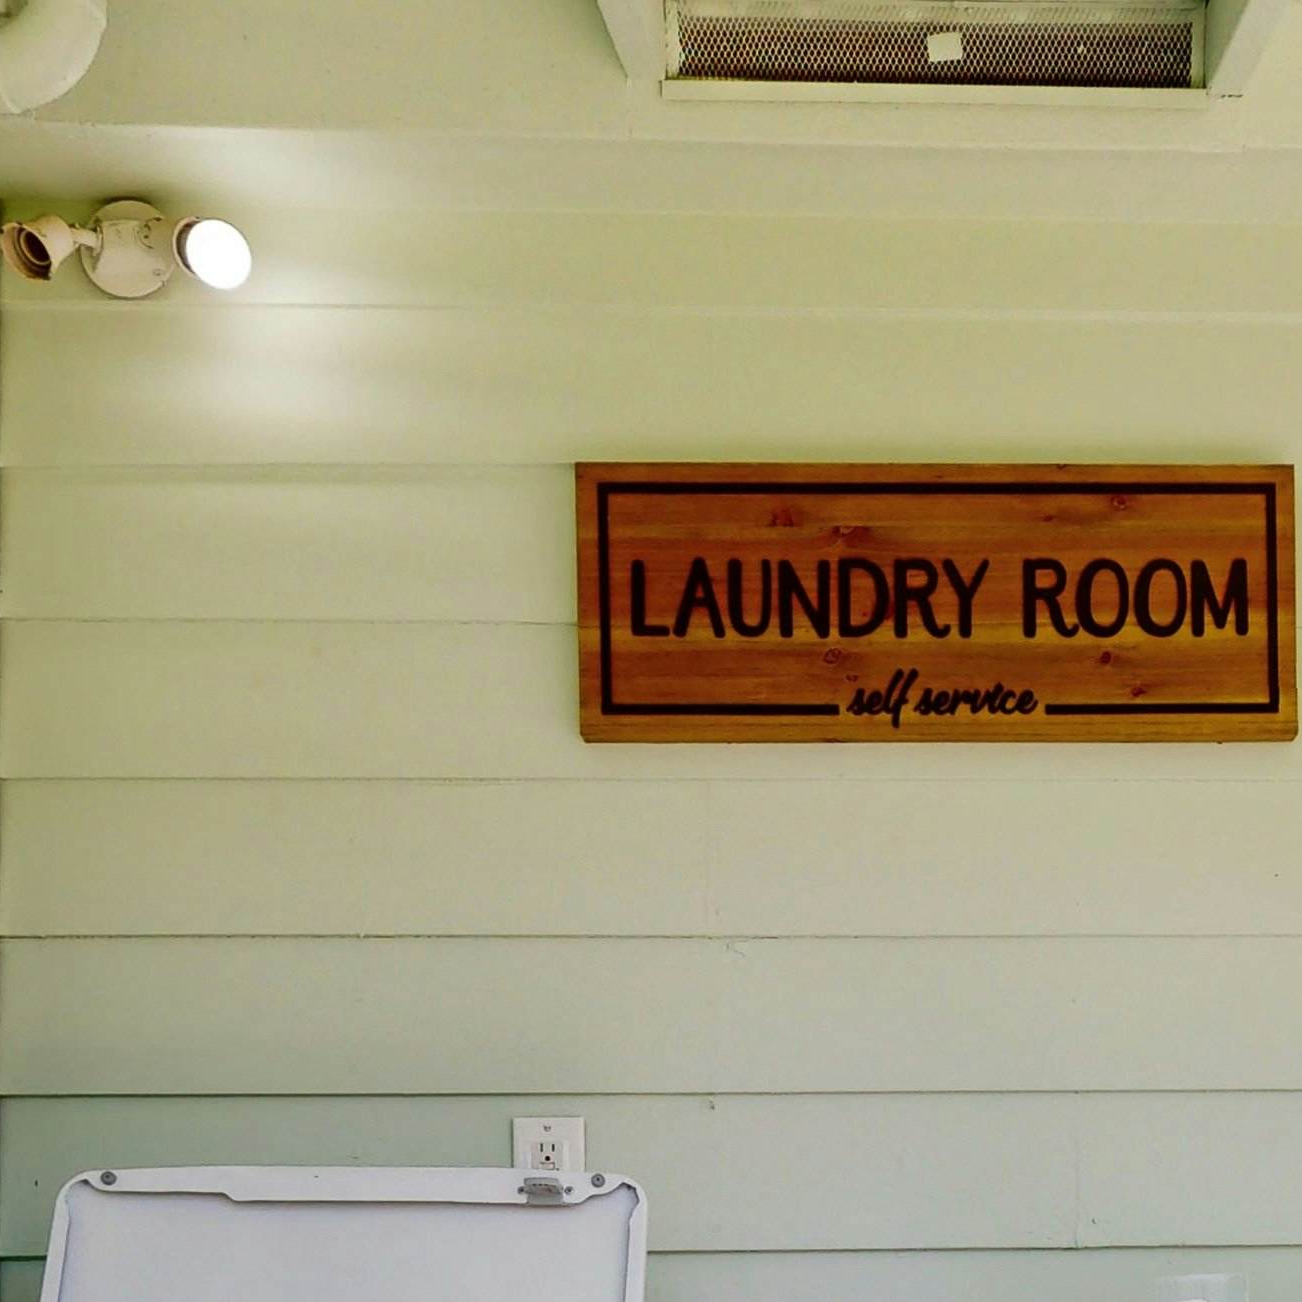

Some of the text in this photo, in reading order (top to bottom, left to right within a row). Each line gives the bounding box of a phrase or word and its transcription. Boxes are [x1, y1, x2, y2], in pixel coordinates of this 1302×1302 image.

[629, 556, 1249, 639] LAUNDRY ROOM
[846, 668, 1038, 728] self service
